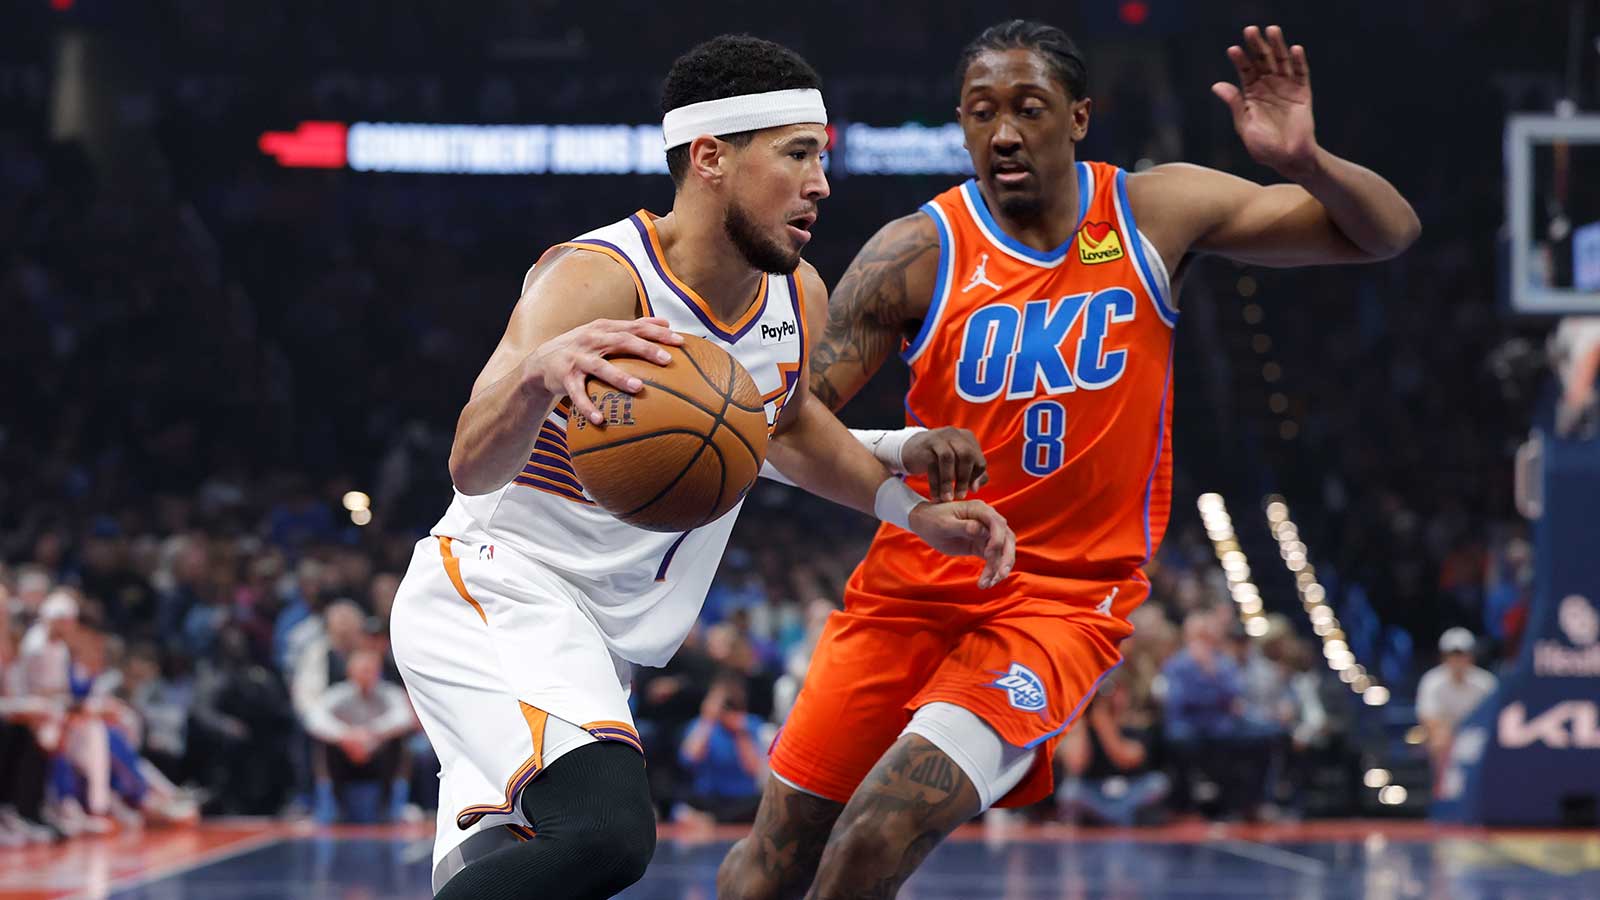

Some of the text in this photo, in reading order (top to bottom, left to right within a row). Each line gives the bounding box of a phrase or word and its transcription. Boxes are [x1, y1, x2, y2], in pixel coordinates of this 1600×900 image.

[761, 319, 796, 342] PayPal
[954, 286, 1136, 403] OKC
[1021, 399, 1067, 477] 8
